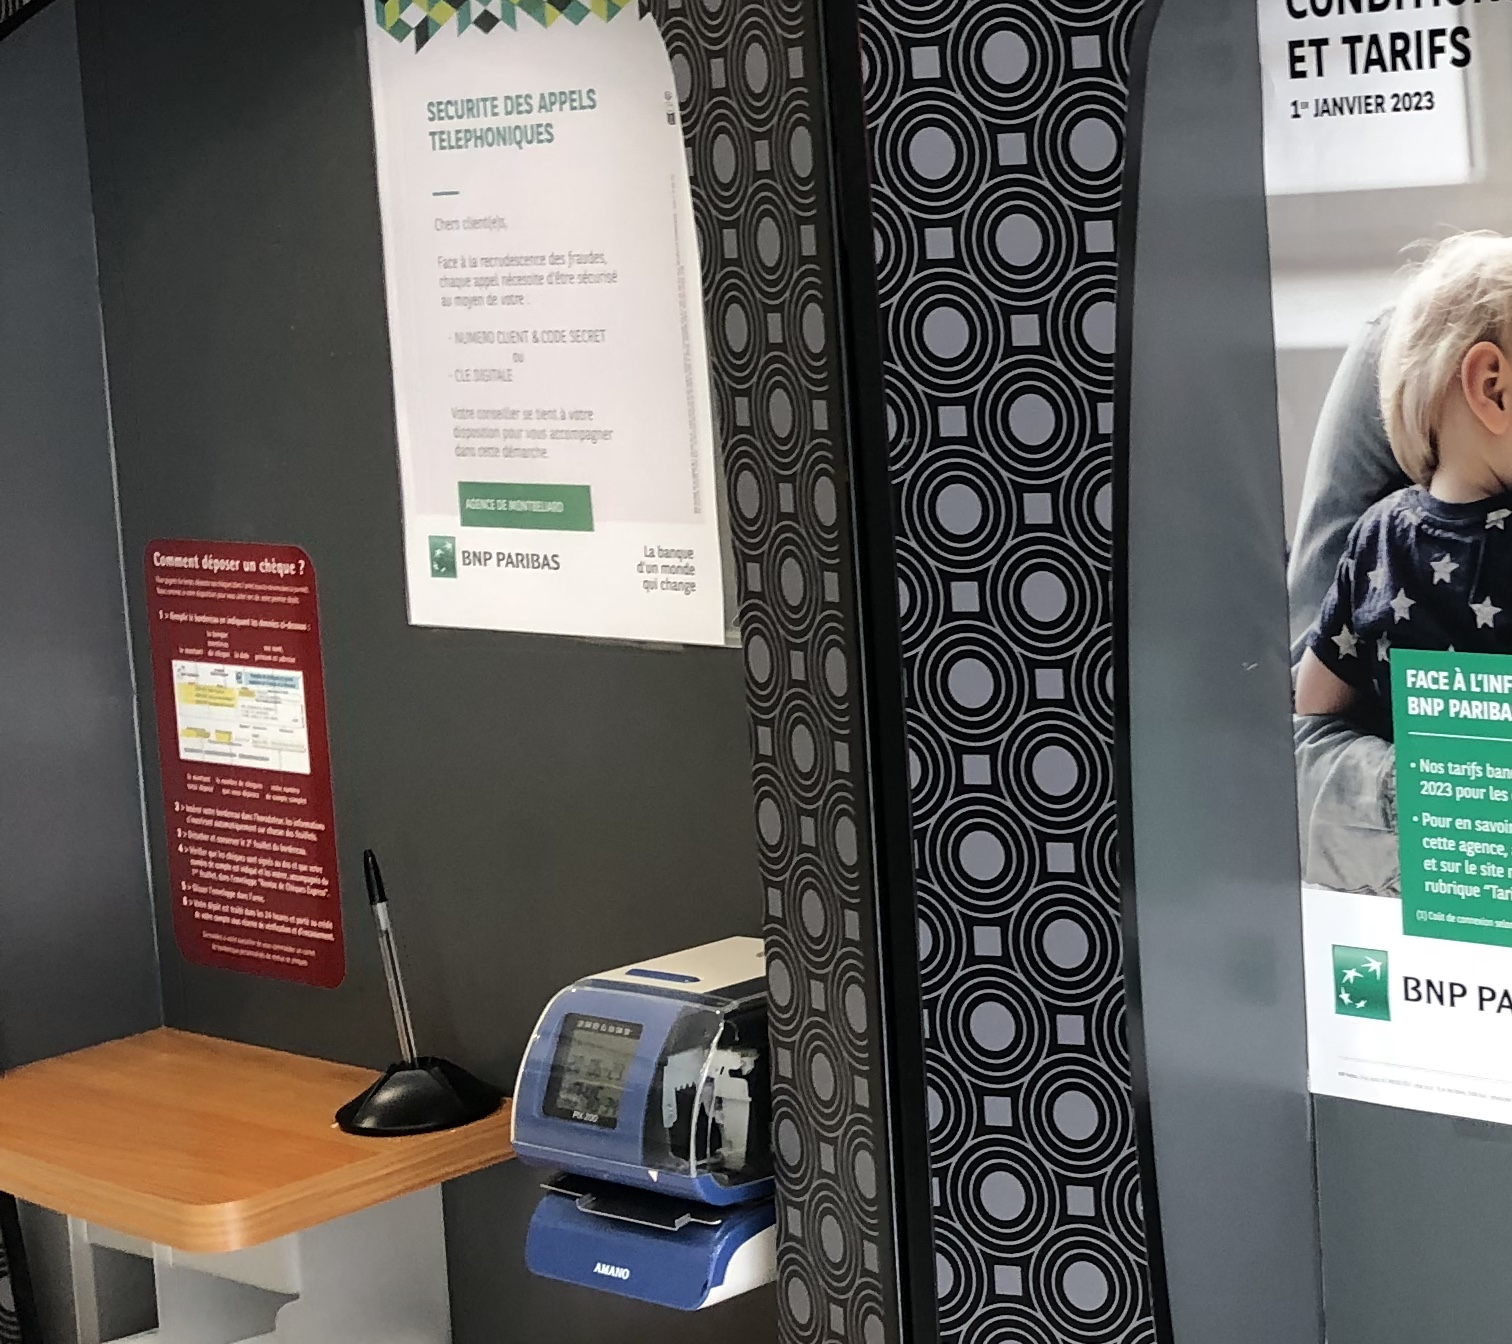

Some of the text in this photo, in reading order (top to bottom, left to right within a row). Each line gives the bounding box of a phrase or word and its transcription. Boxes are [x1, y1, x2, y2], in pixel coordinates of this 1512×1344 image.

[1287, 25, 1472, 80] ET TARIFS
[426, 87, 597, 122] SECURITE DES APPELS
[1313, 93, 1386, 118] JANVIER
[1390, 91, 1435, 112] 2023
[428, 122, 554, 151] TELEPHONIQUES
[153, 551, 305, 578] Comment déposer un chèque ?
[461, 549, 560, 571] BNP PARIBAS
[643, 545, 694, 562] La banque
[636, 560, 696, 576] d'un monde
[642, 577, 696, 596] qui change
[1405, 668, 1449, 690] FACE
[1452, 667, 1467, 691] À
[1407, 696, 1444, 716] BNP
[1419, 758, 1445, 774] Nos
[1446, 761, 1483, 780] tarifs
[1419, 780, 1453, 797] 2023
[1455, 786, 1487, 801] pour
[1488, 785, 1509, 802] les
[1421, 811, 1453, 828] Pour
[1454, 817, 1472, 830] en
[1421, 836, 1456, 851] cette
[1458, 840, 1508, 858] agence,
[1423, 857, 1438, 871] et
[1439, 860, 1462, 873] sur
[1464, 859, 1477, 875] le
[1479, 861, 1504, 878] site
[1424, 878, 1481, 900] rubrique
[1403, 975, 1467, 1007] BNP
[593, 1262, 630, 1280] AMANO
